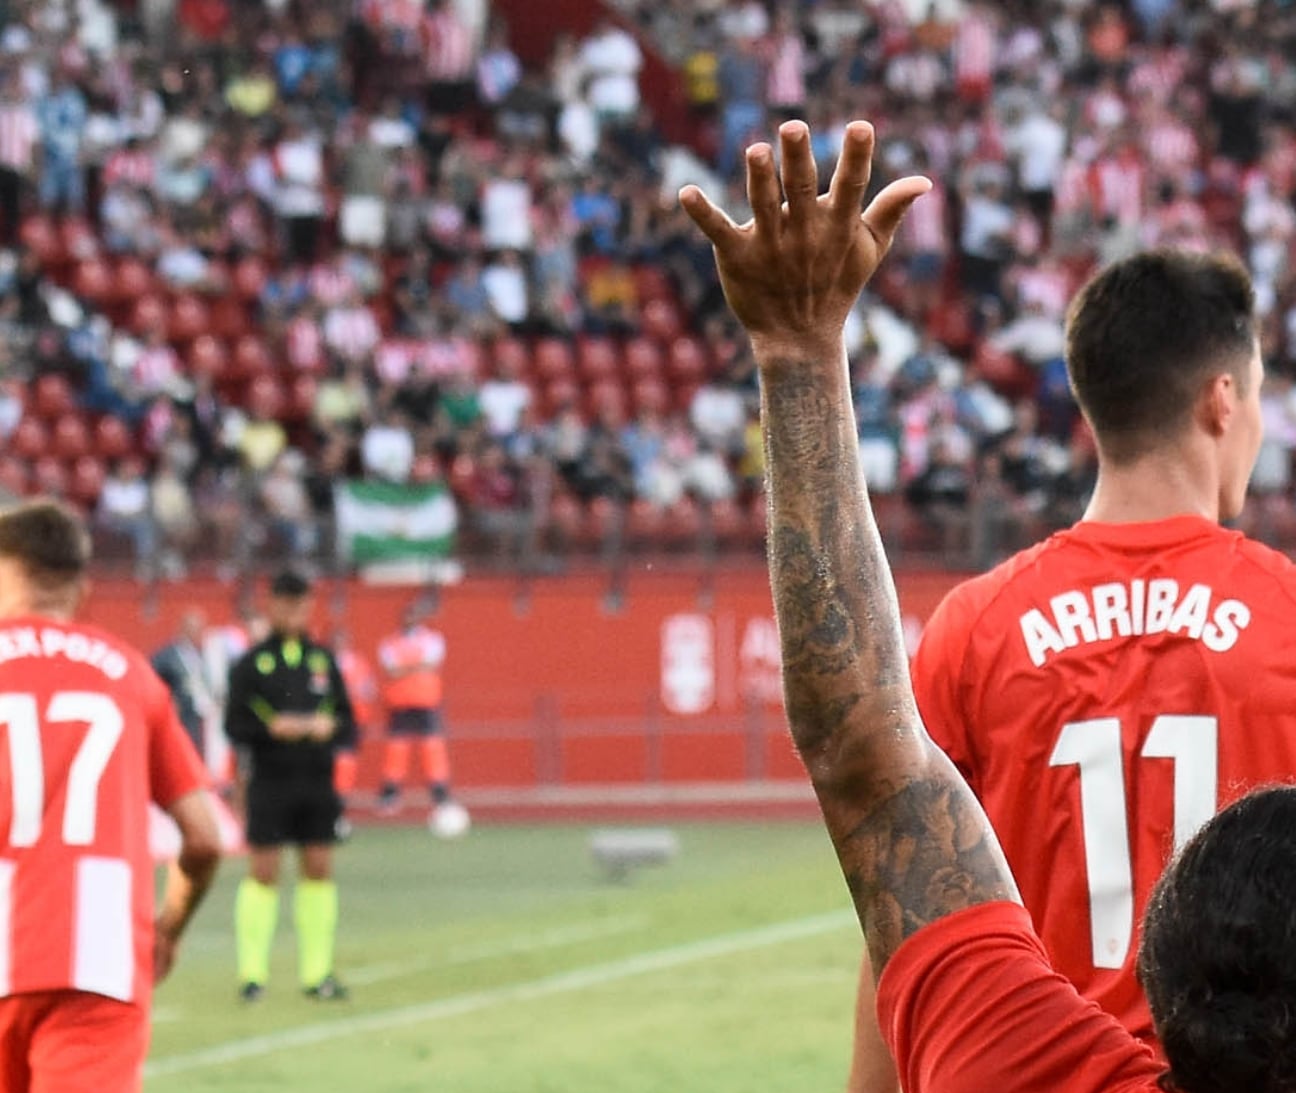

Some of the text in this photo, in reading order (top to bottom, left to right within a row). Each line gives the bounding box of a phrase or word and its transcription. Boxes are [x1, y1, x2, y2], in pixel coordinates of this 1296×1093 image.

[1019, 578, 1251, 667] ARRIBAS
[0, 692, 124, 847] 17
[1048, 714, 1218, 969] 11
